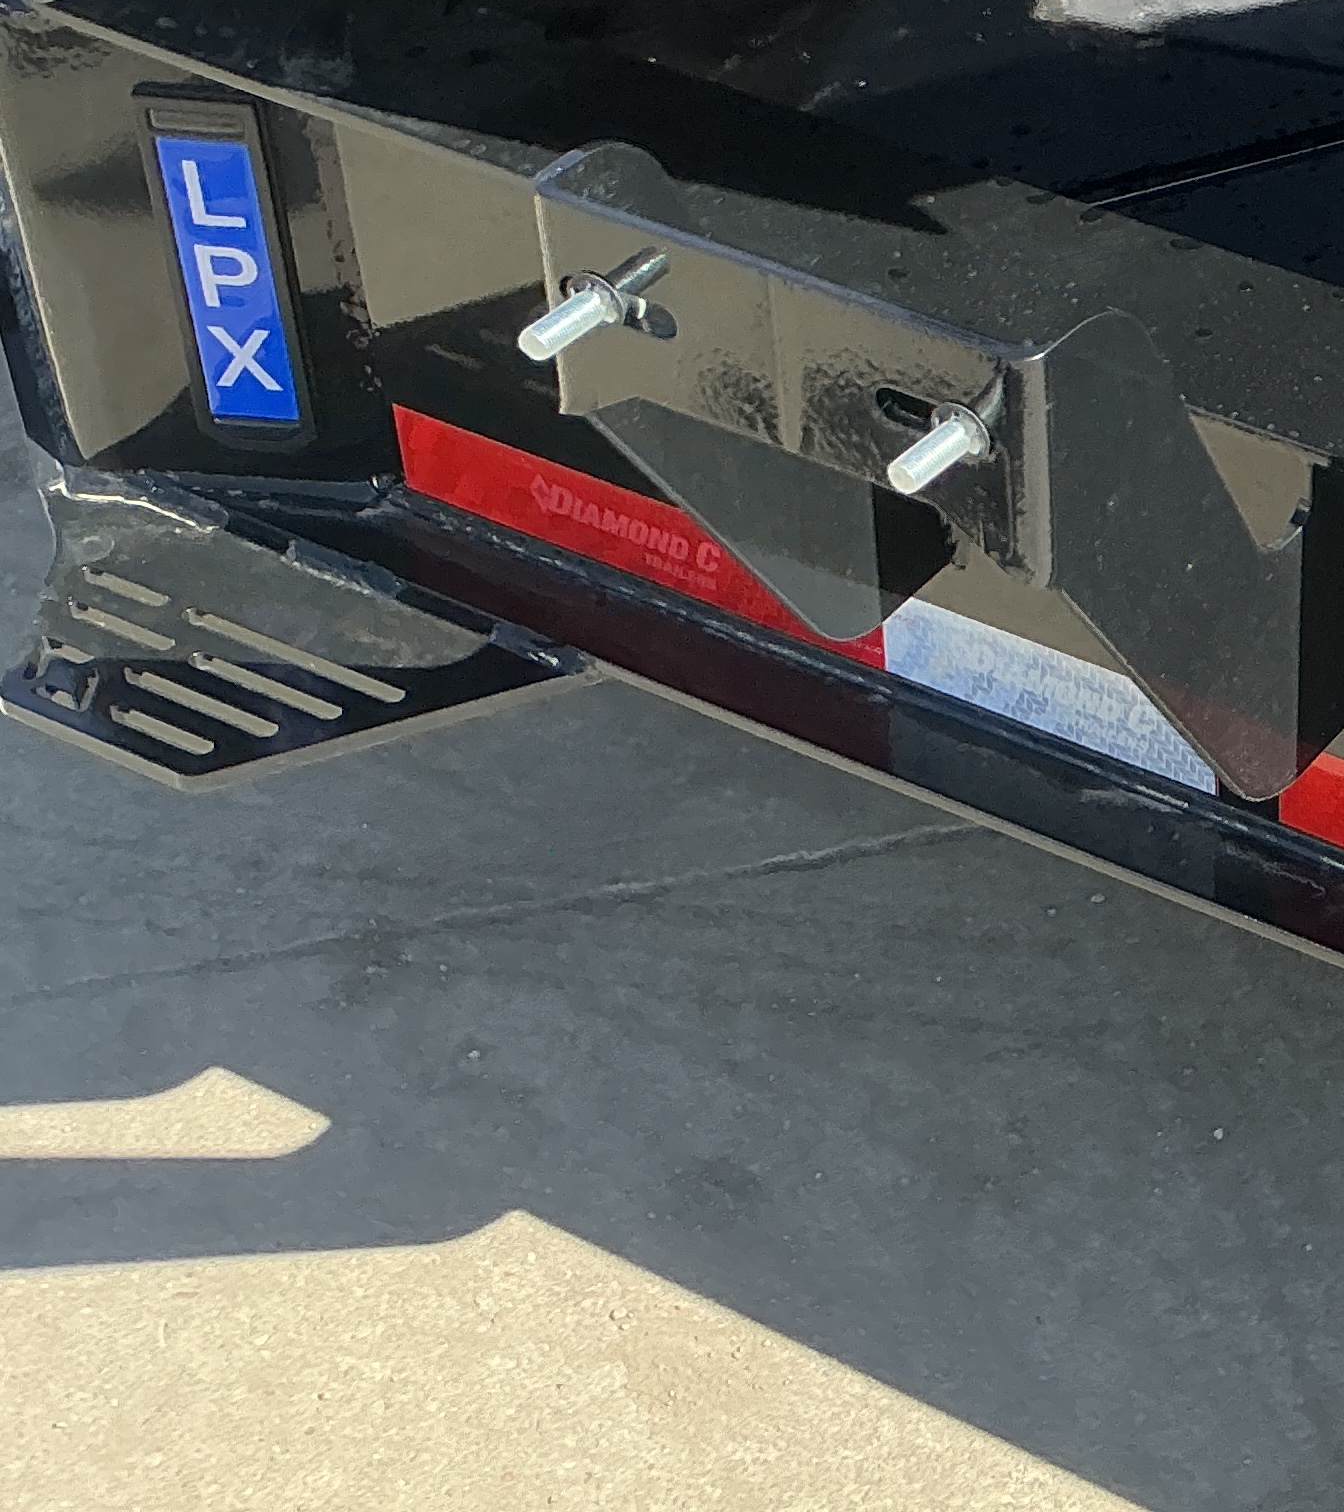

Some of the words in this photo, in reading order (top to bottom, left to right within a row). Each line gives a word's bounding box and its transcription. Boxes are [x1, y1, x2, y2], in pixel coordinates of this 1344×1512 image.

[180, 159, 283, 392] LPX
[547, 483, 689, 561] DIAMOND
[695, 541, 722, 573] C
